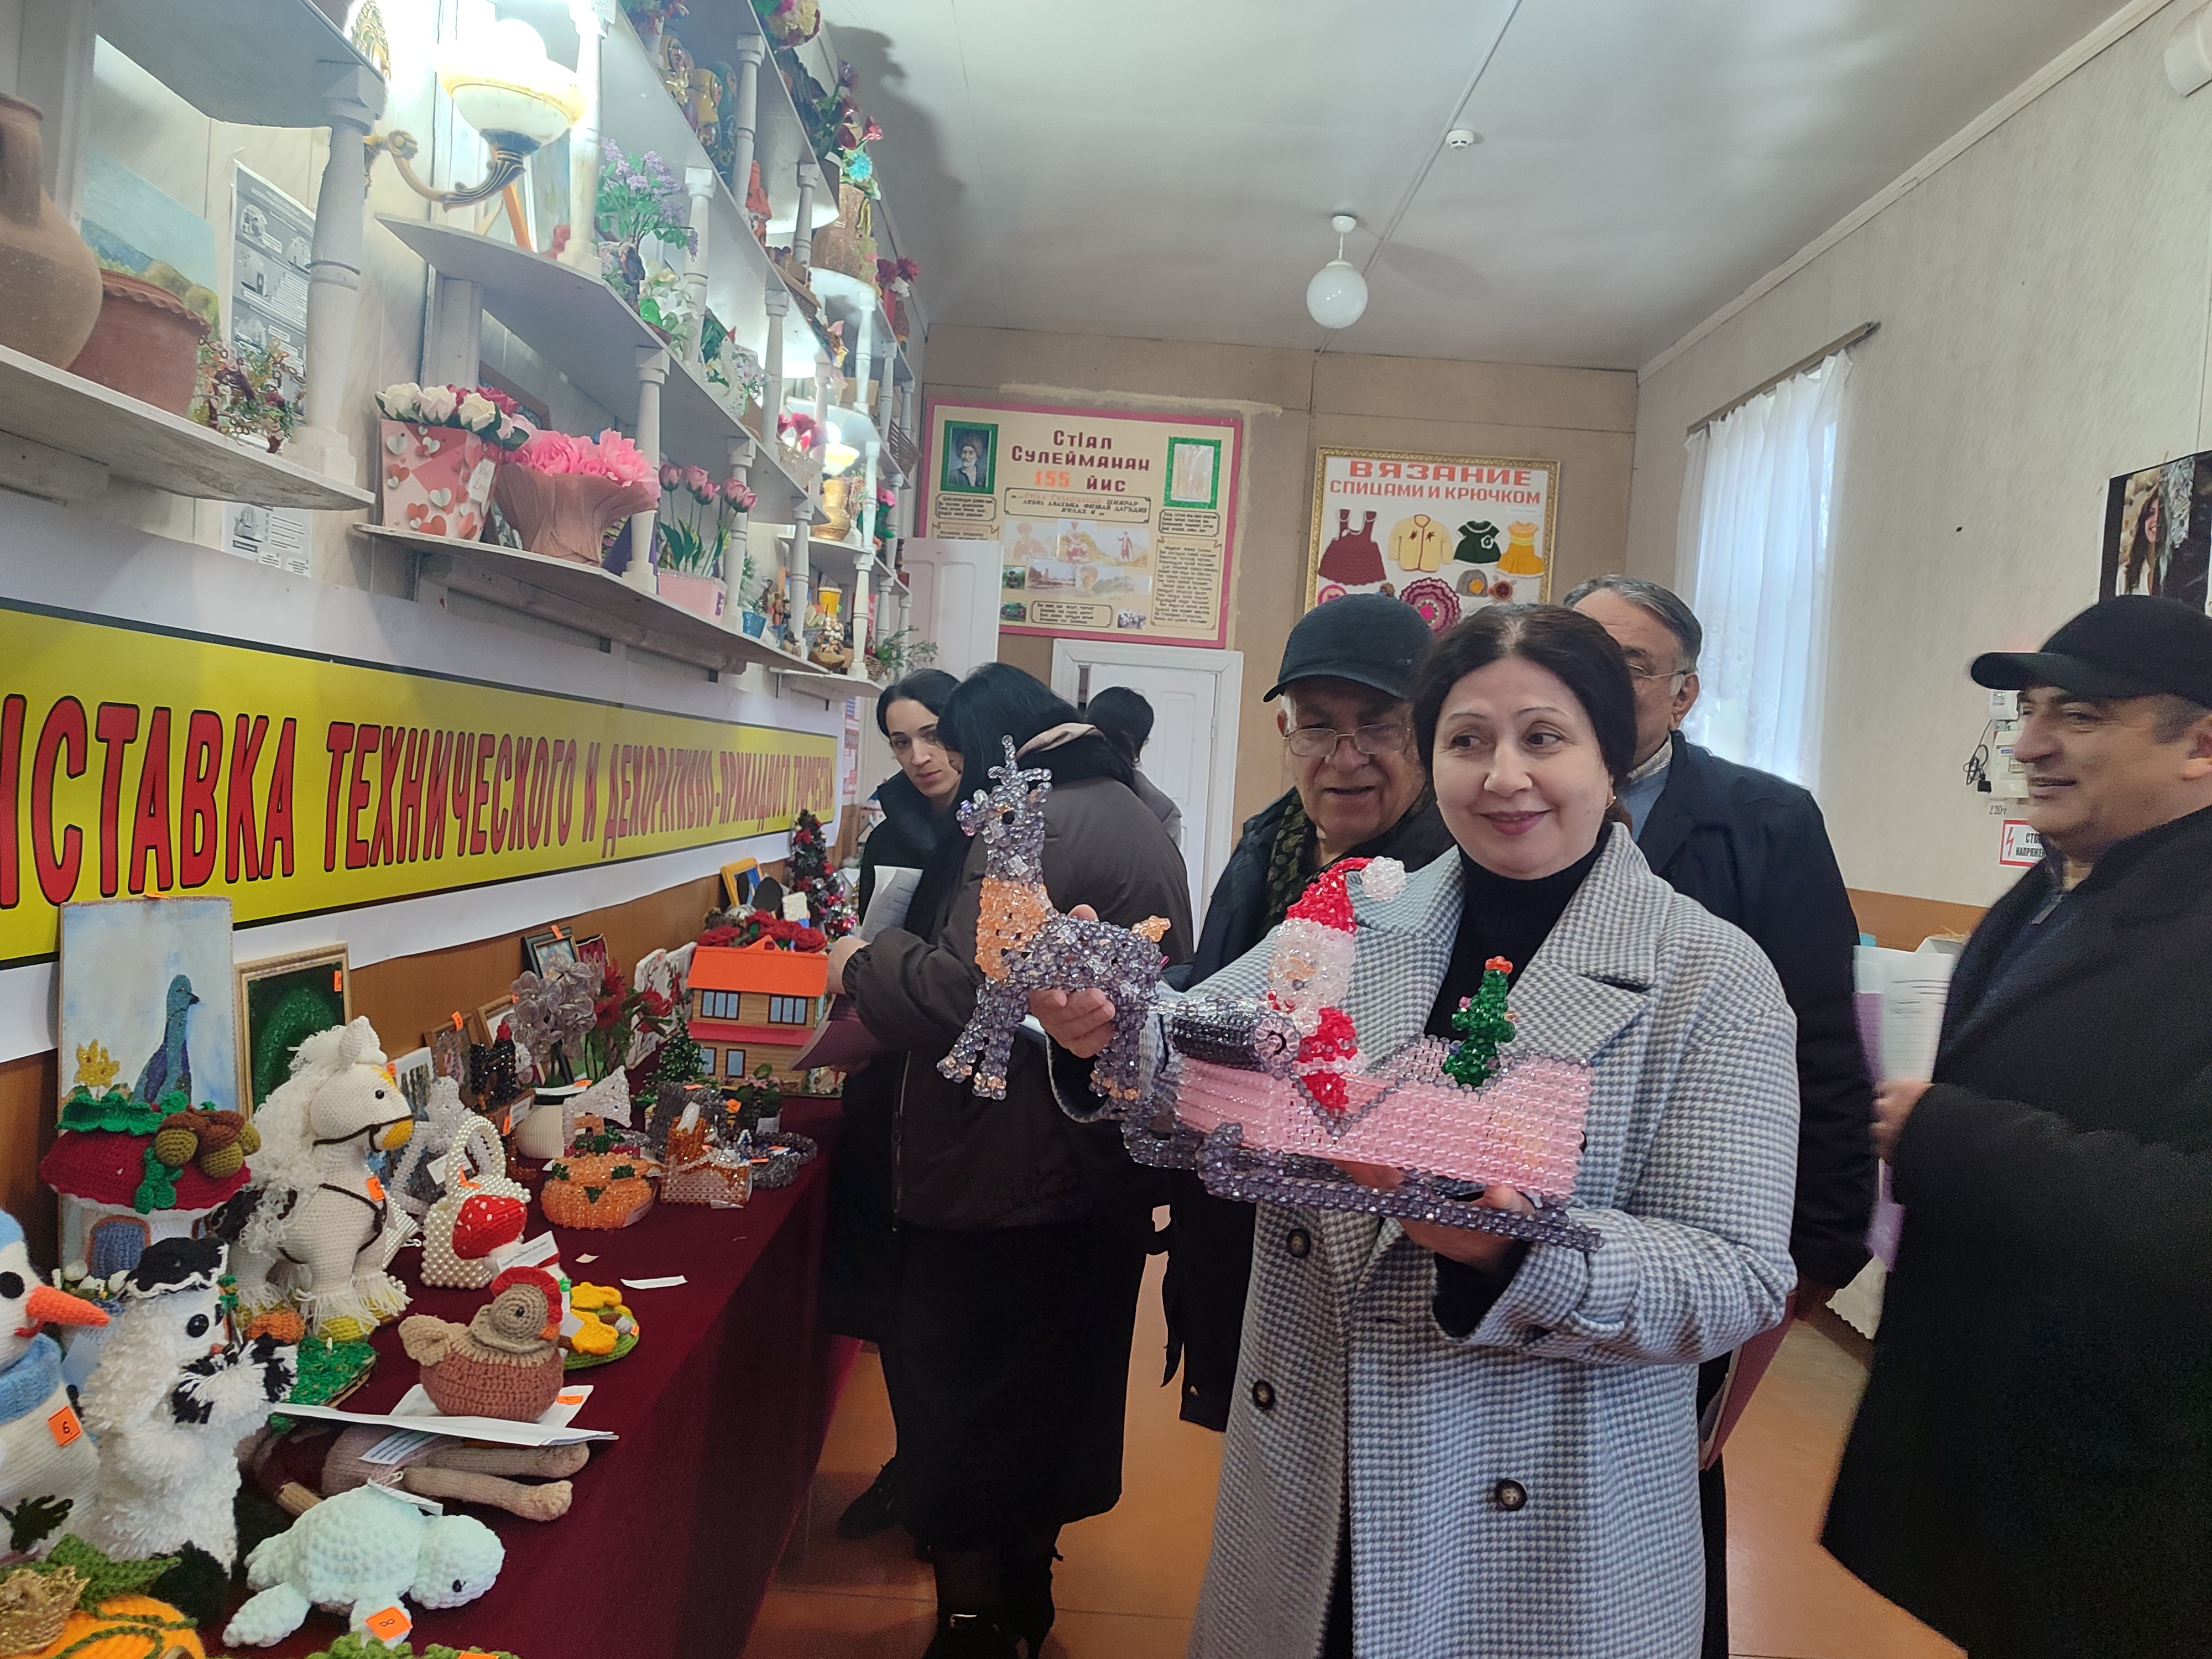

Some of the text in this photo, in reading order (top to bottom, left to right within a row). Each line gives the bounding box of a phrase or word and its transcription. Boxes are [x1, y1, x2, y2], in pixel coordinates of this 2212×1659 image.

[1035, 471, 1070, 488] 155
[1349, 460, 1531, 487] ВЯЗАНИЕ
[1329, 480, 1541, 504] СПИЦАМИ И КРЮЧКОМ
[324, 721, 577, 873] ТЕХНИЧЕСКОГО
[582, 742, 601, 843] И
